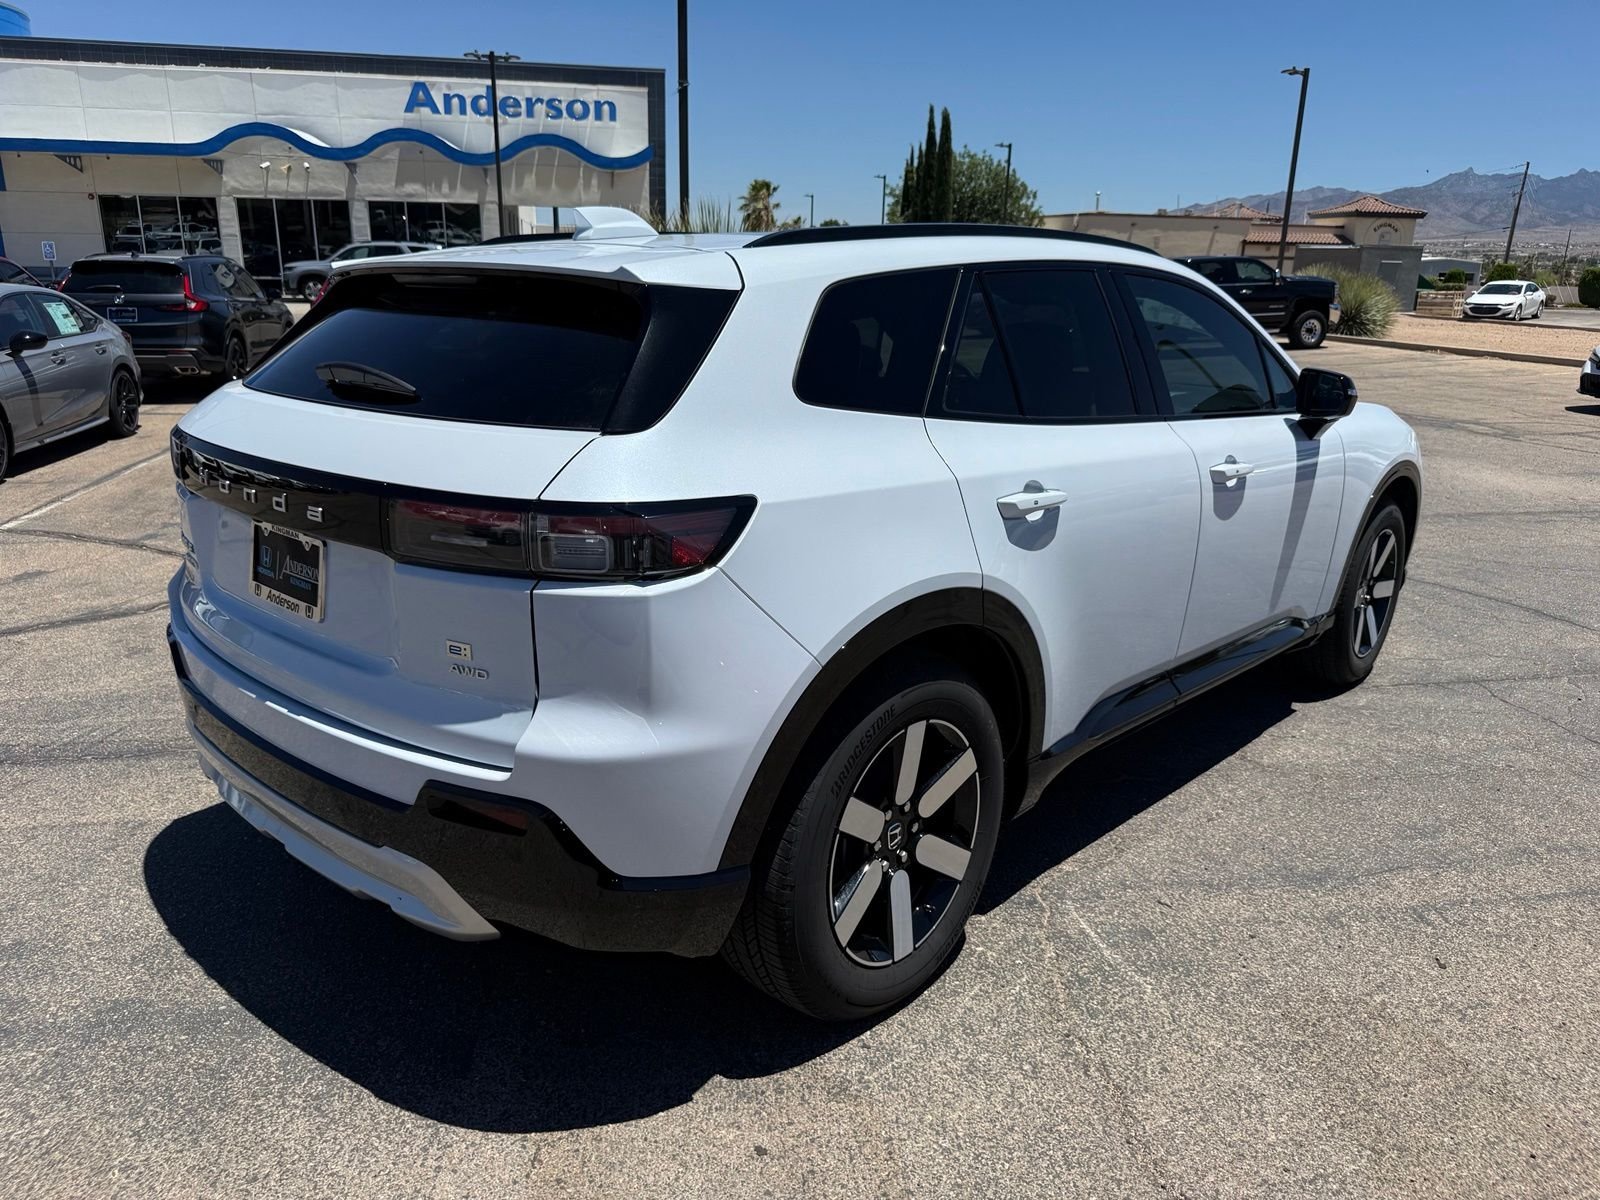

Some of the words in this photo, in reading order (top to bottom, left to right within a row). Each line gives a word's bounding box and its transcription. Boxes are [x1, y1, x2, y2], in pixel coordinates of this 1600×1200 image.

[403, 81, 617, 122] Anderson
[271, 525, 300, 540] KINGMAN
[266, 589, 300, 614] Anderson
[449, 663, 489, 680] AWD
[831, 703, 896, 798] BRIDGESTONE
